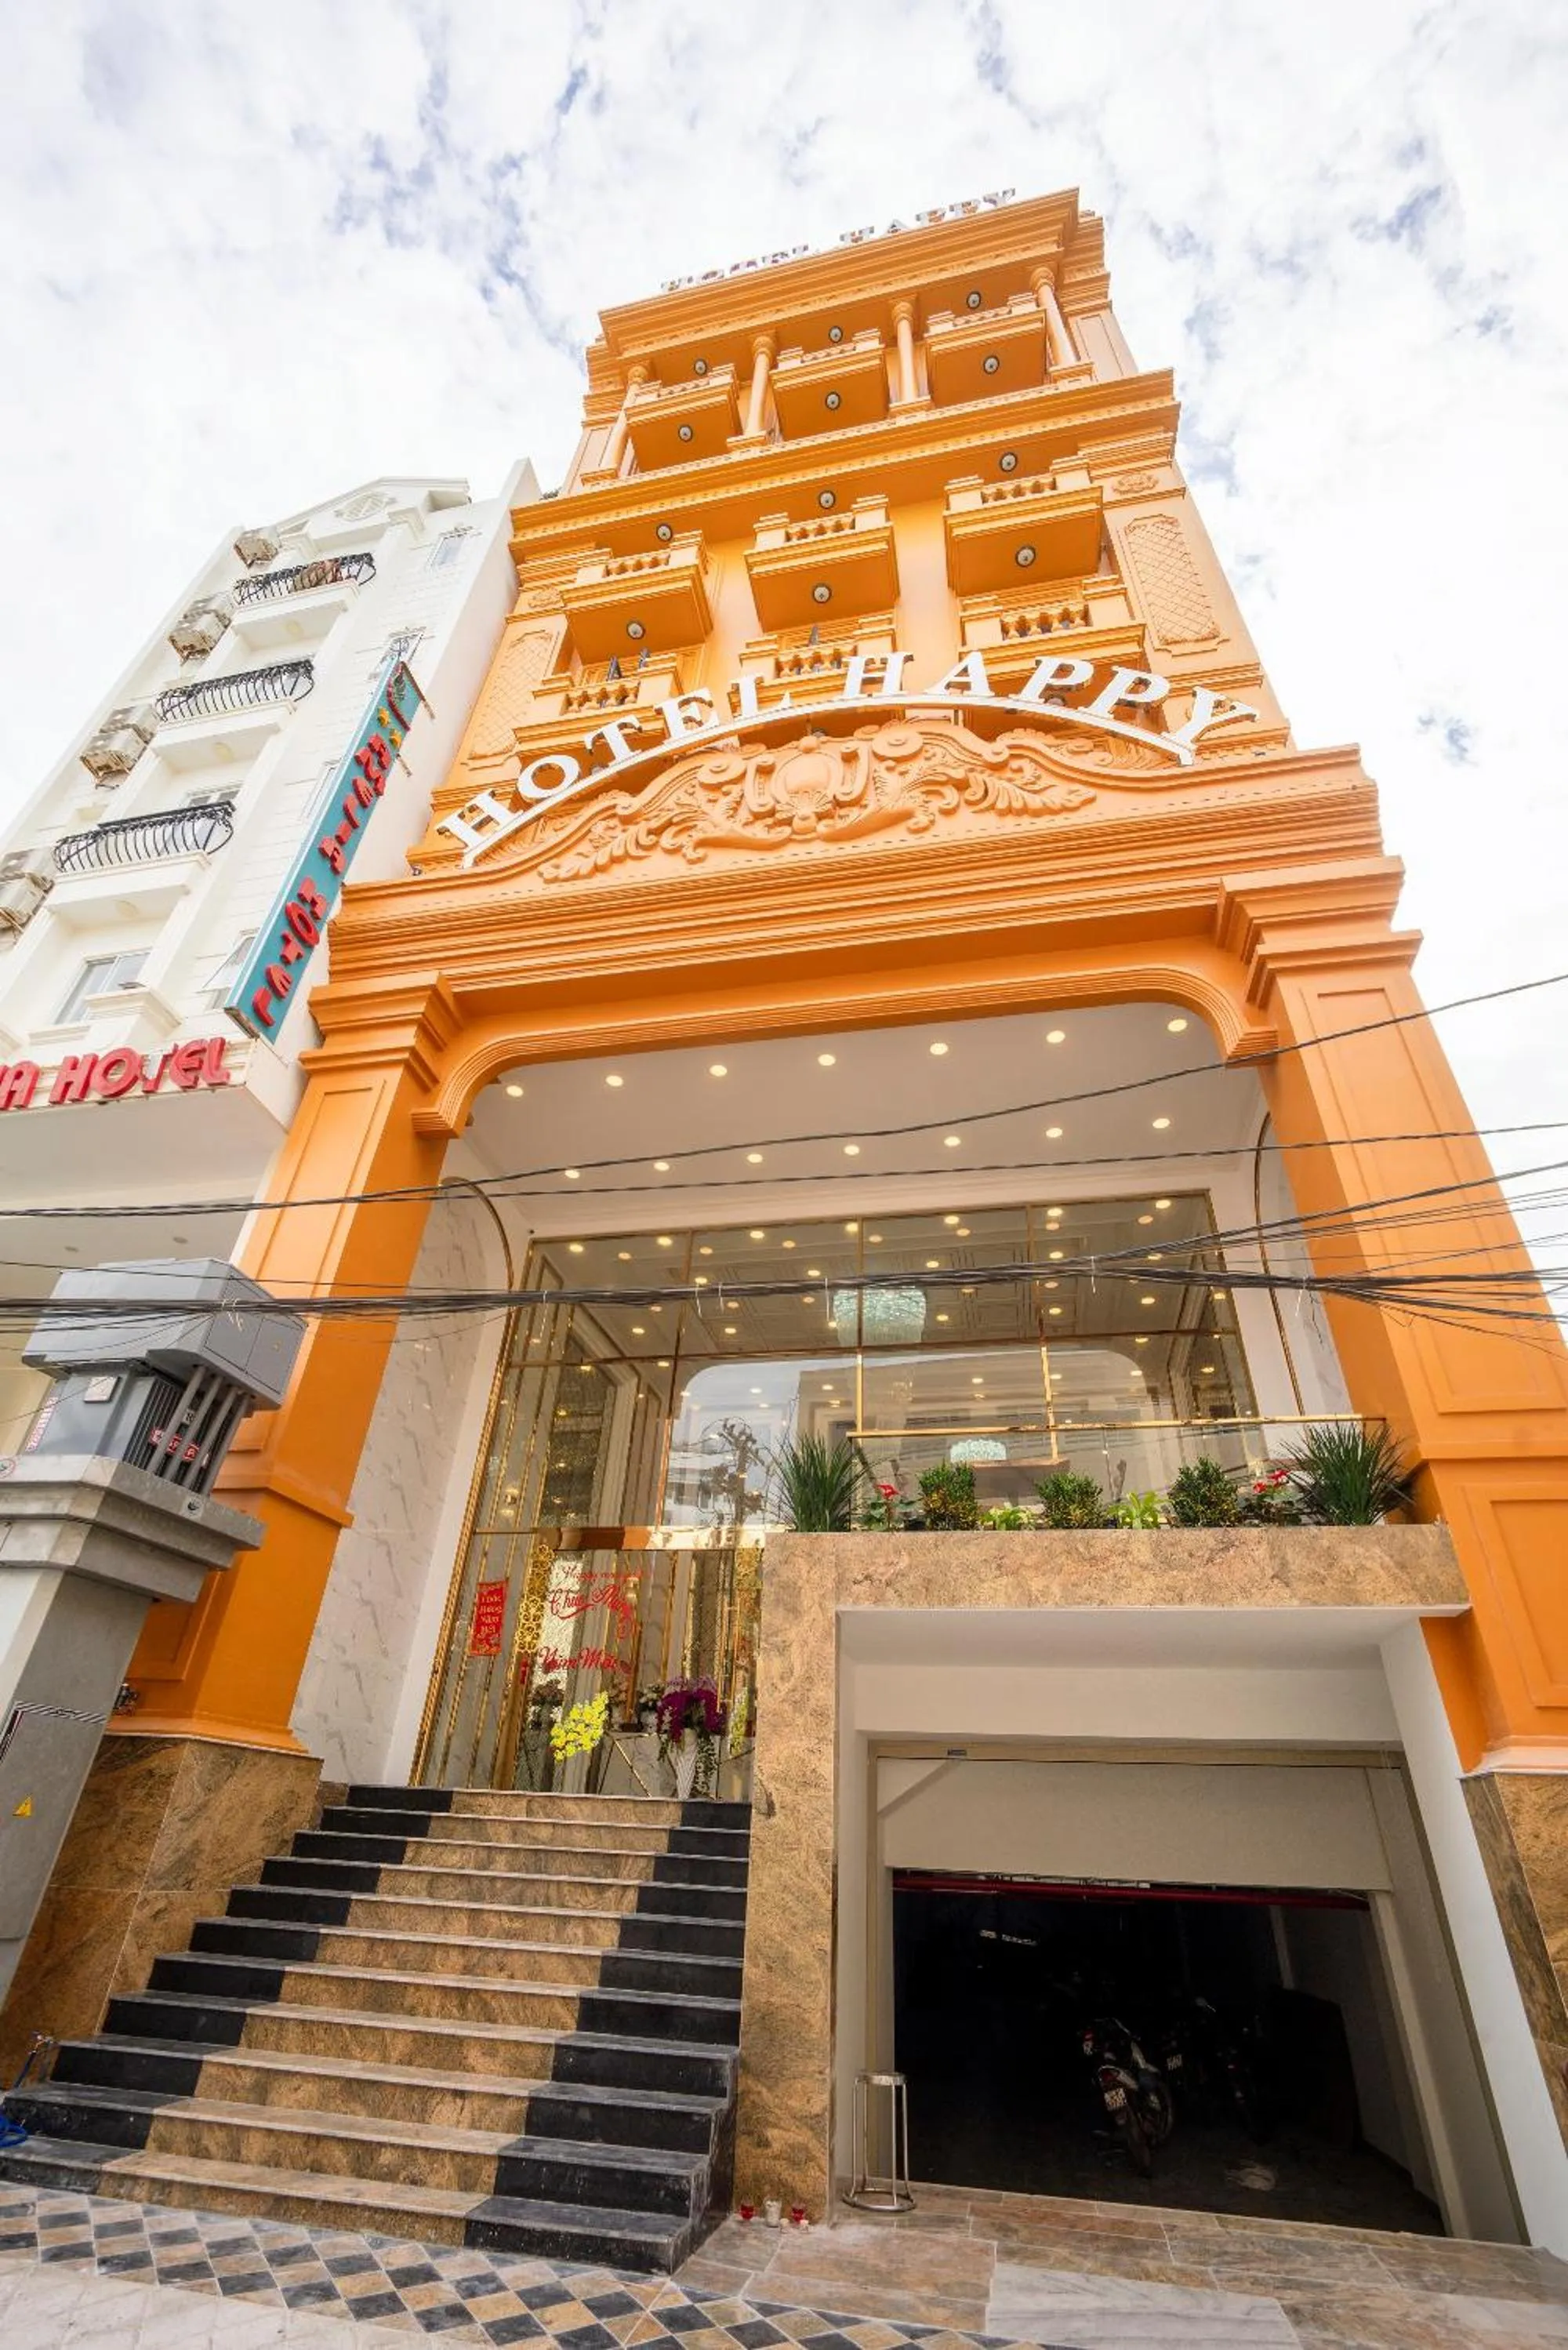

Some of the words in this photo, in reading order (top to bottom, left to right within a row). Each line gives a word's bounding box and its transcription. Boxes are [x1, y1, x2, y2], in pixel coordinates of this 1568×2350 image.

[318, 732, 392, 876] AMELIA
[434, 674, 792, 858] HOTEL
[833, 650, 1260, 750] HAPPY
[252, 875, 328, 1027] HOTEL
[48, 1036, 231, 1106] HOTEL
